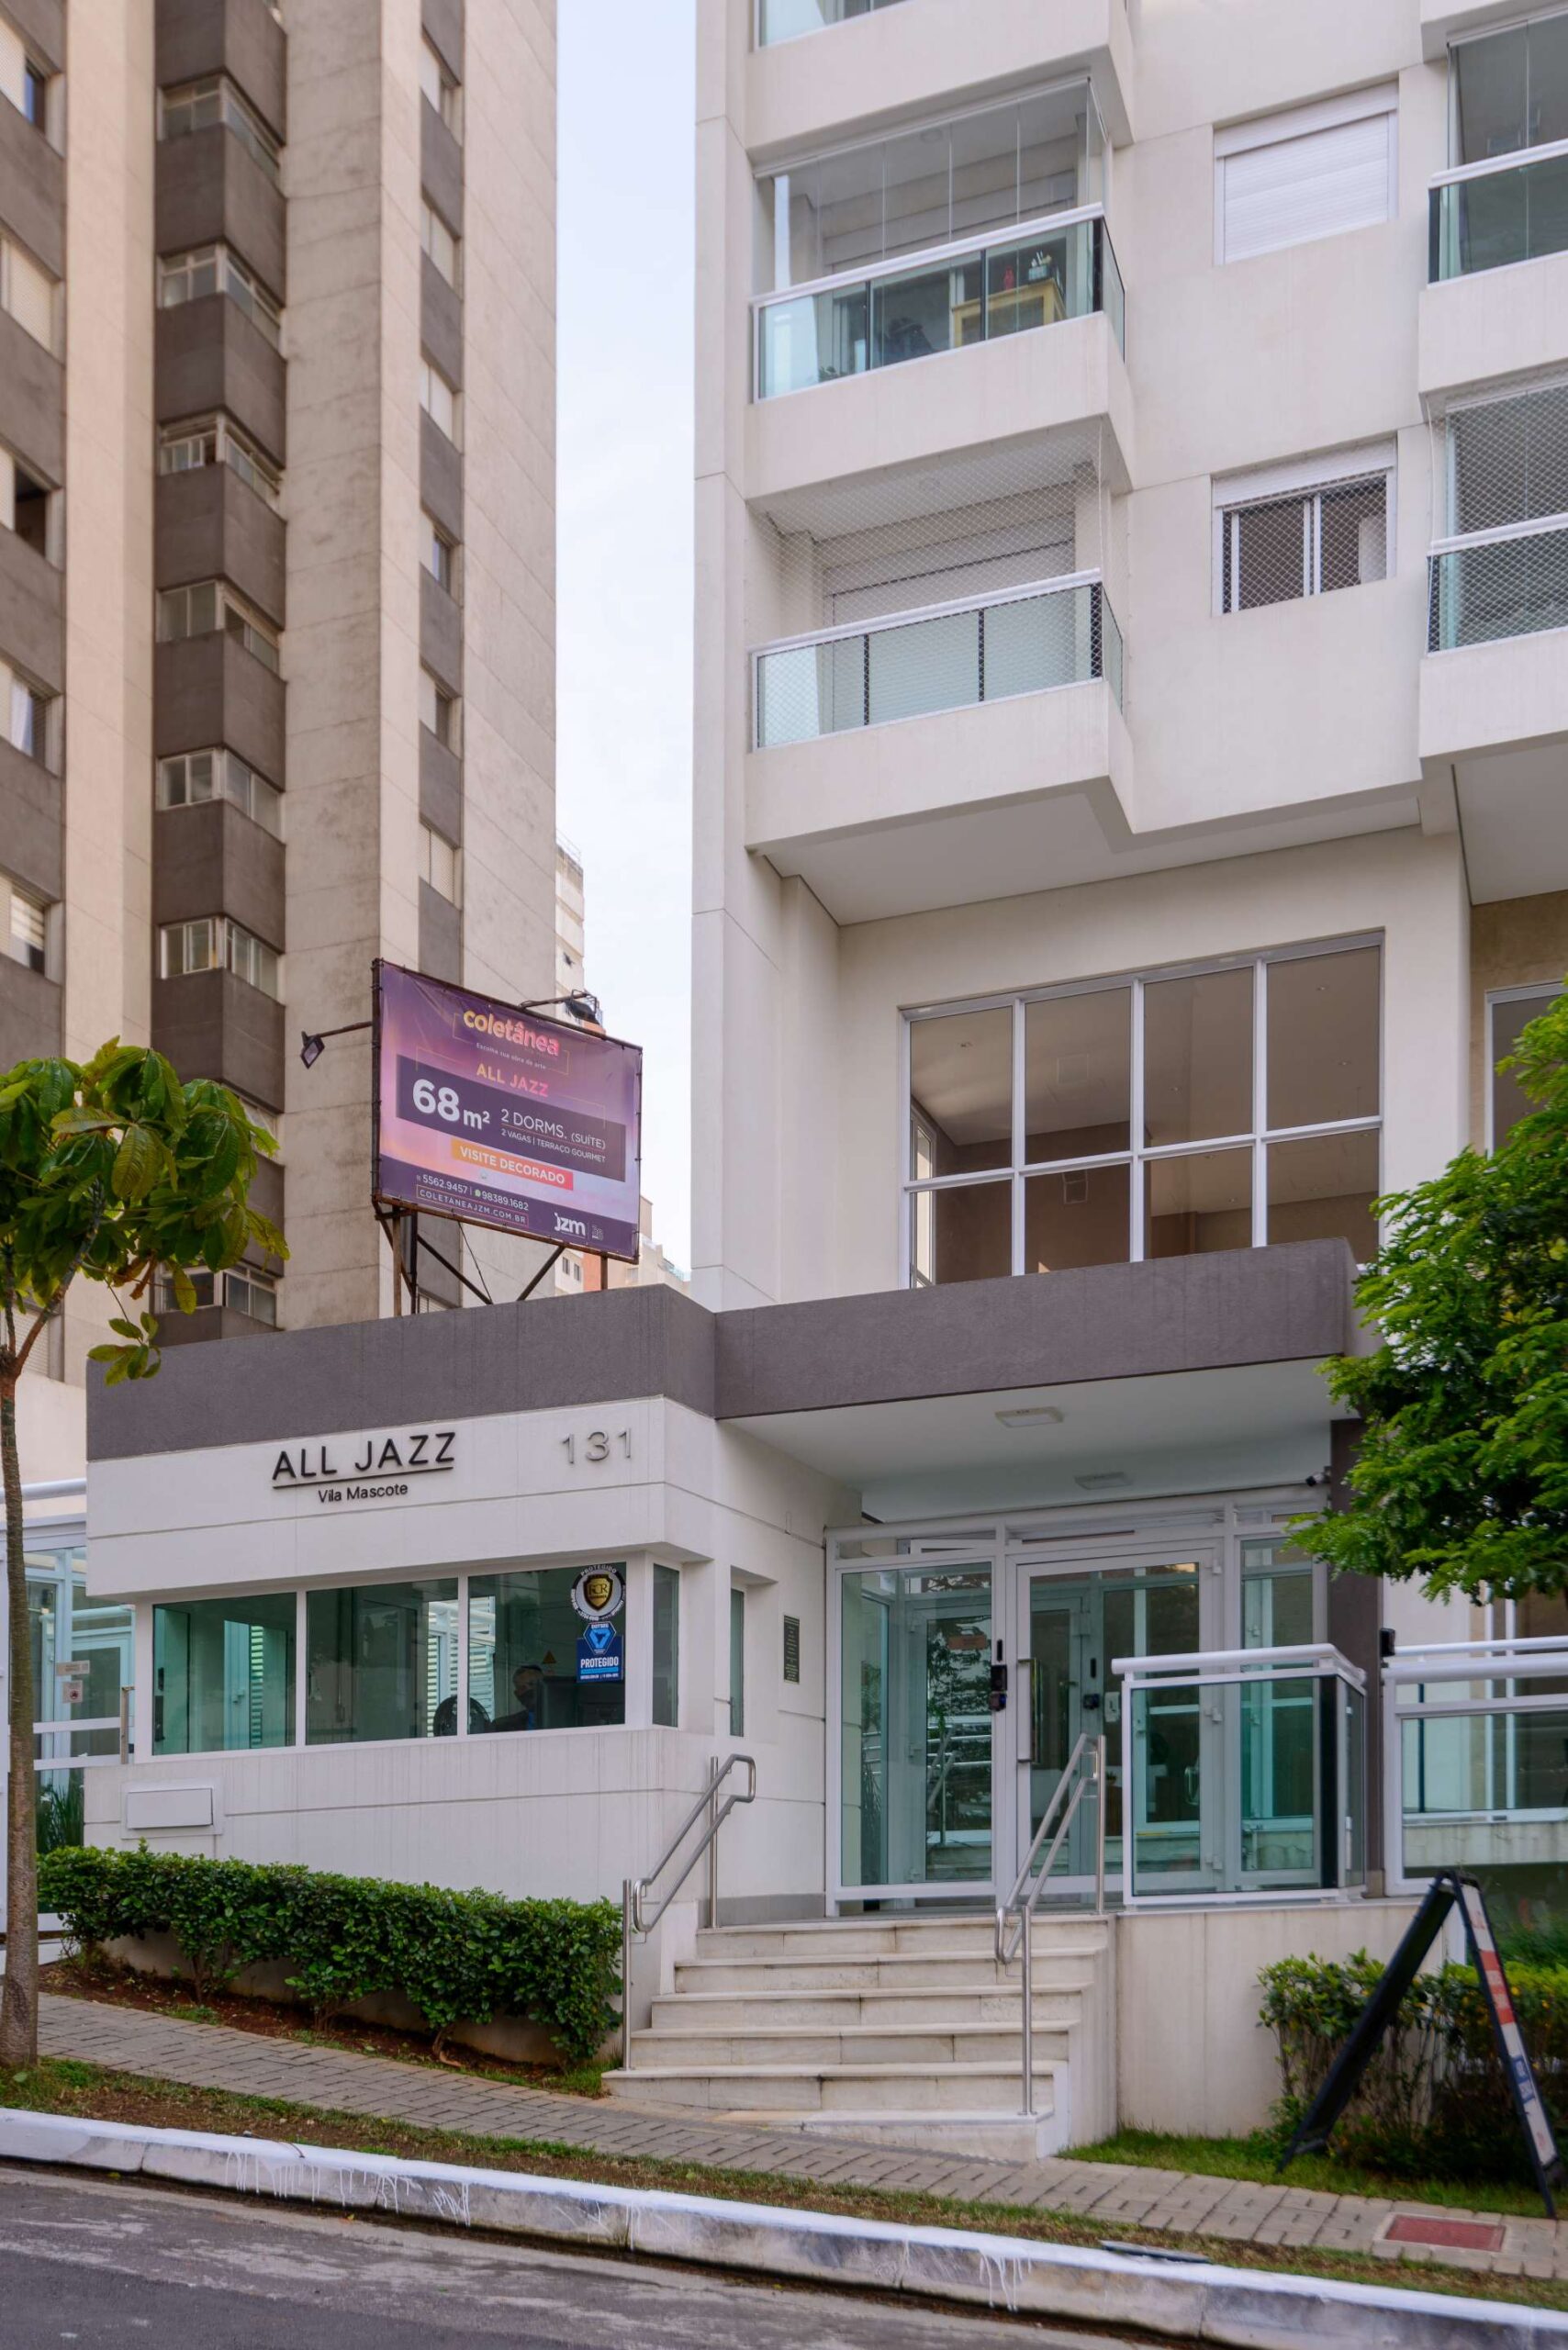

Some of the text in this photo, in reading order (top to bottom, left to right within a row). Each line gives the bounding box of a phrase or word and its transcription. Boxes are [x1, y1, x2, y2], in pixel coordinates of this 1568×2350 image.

[464, 1010, 559, 1057] coletânea
[476, 1063, 549, 1098] ALL JAZZ
[412, 1078, 460, 1123] 68
[500, 1108, 606, 1150] 2 DORMS. (SUÍTE)
[501, 1128, 507, 1136] 2
[507, 1130, 532, 1144] VAGAS
[537, 1138, 570, 1154] TERRAÇO
[571, 1147, 606, 1163] GOURMET
[460, 1146, 566, 1184] VISITE DECORADO
[420, 1189, 526, 1224] COLETANEAJZM.COM.BR
[422, 1174, 468, 1194] 5562.9457
[481, 1191, 529, 1211] 98389.1682
[554, 1212, 586, 1237] jzm
[272, 1432, 456, 1481] ALL JAZZ
[560, 1427, 633, 1464] 131
[318, 1483, 409, 1504] Vila Mascote
[580, 1656, 619, 1669] PROTEGIDO
